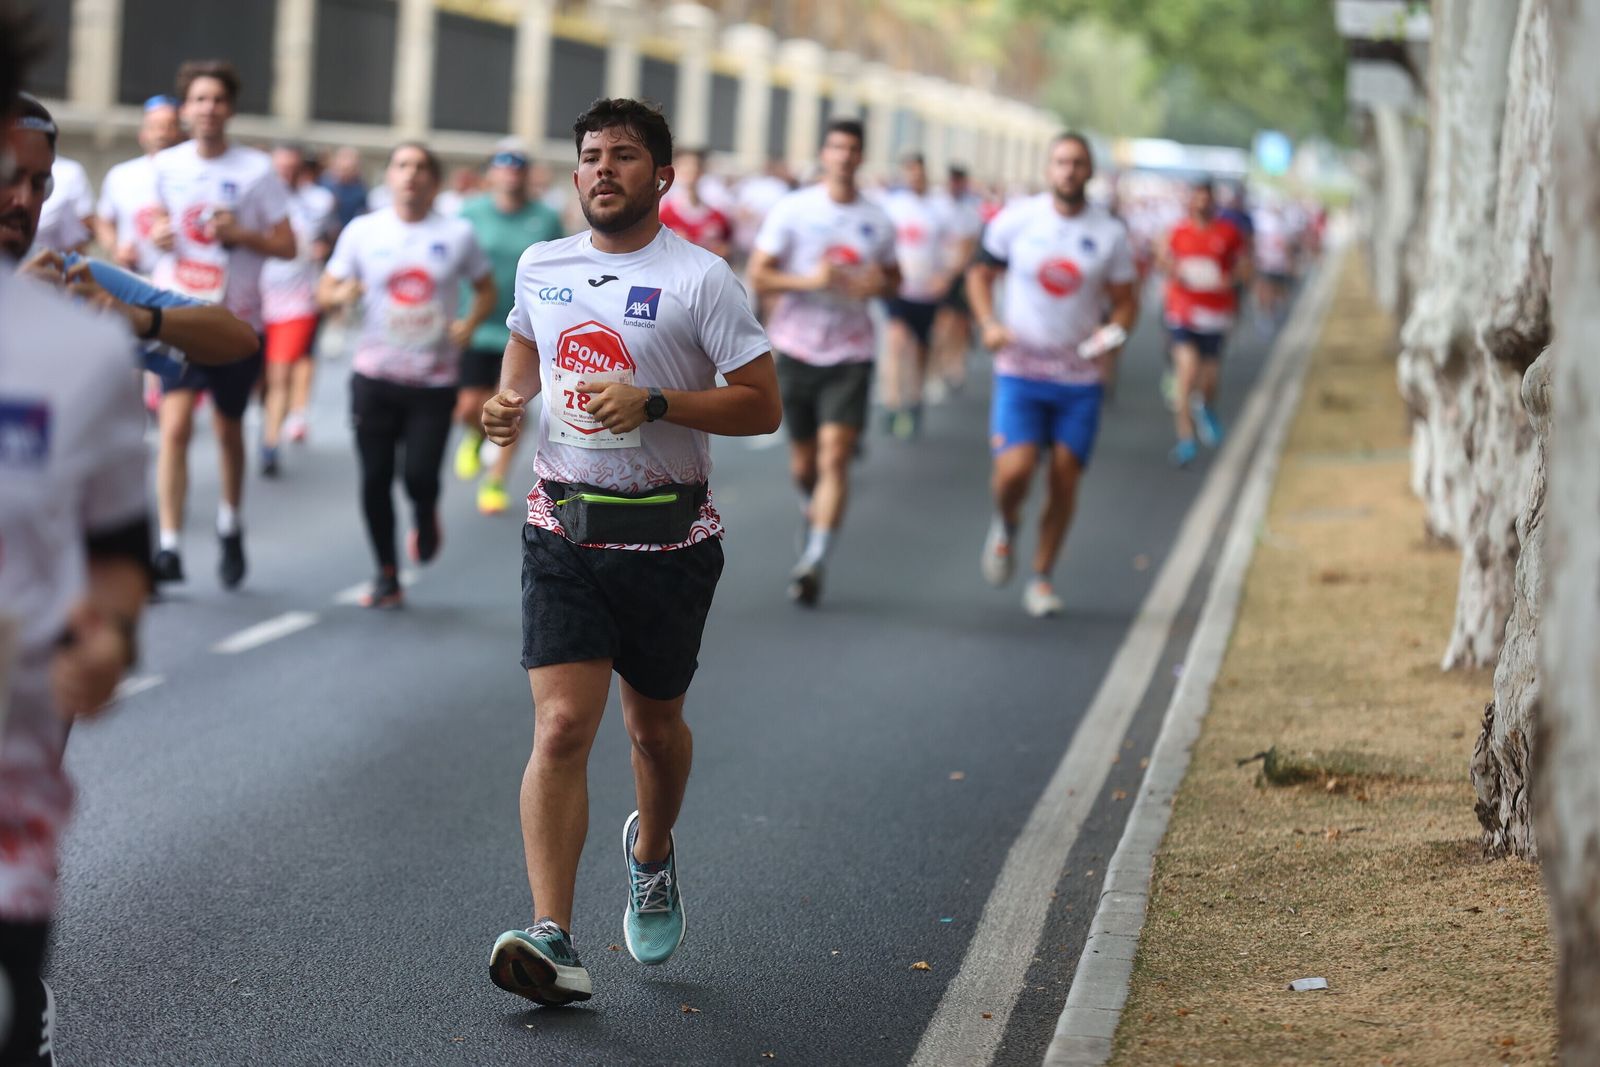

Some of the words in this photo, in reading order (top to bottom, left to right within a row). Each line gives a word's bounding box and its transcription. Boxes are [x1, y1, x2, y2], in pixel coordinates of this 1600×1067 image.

[625, 302, 650, 317] AXA
[623, 319, 655, 329] fundación
[568, 340, 625, 372] PONLE
